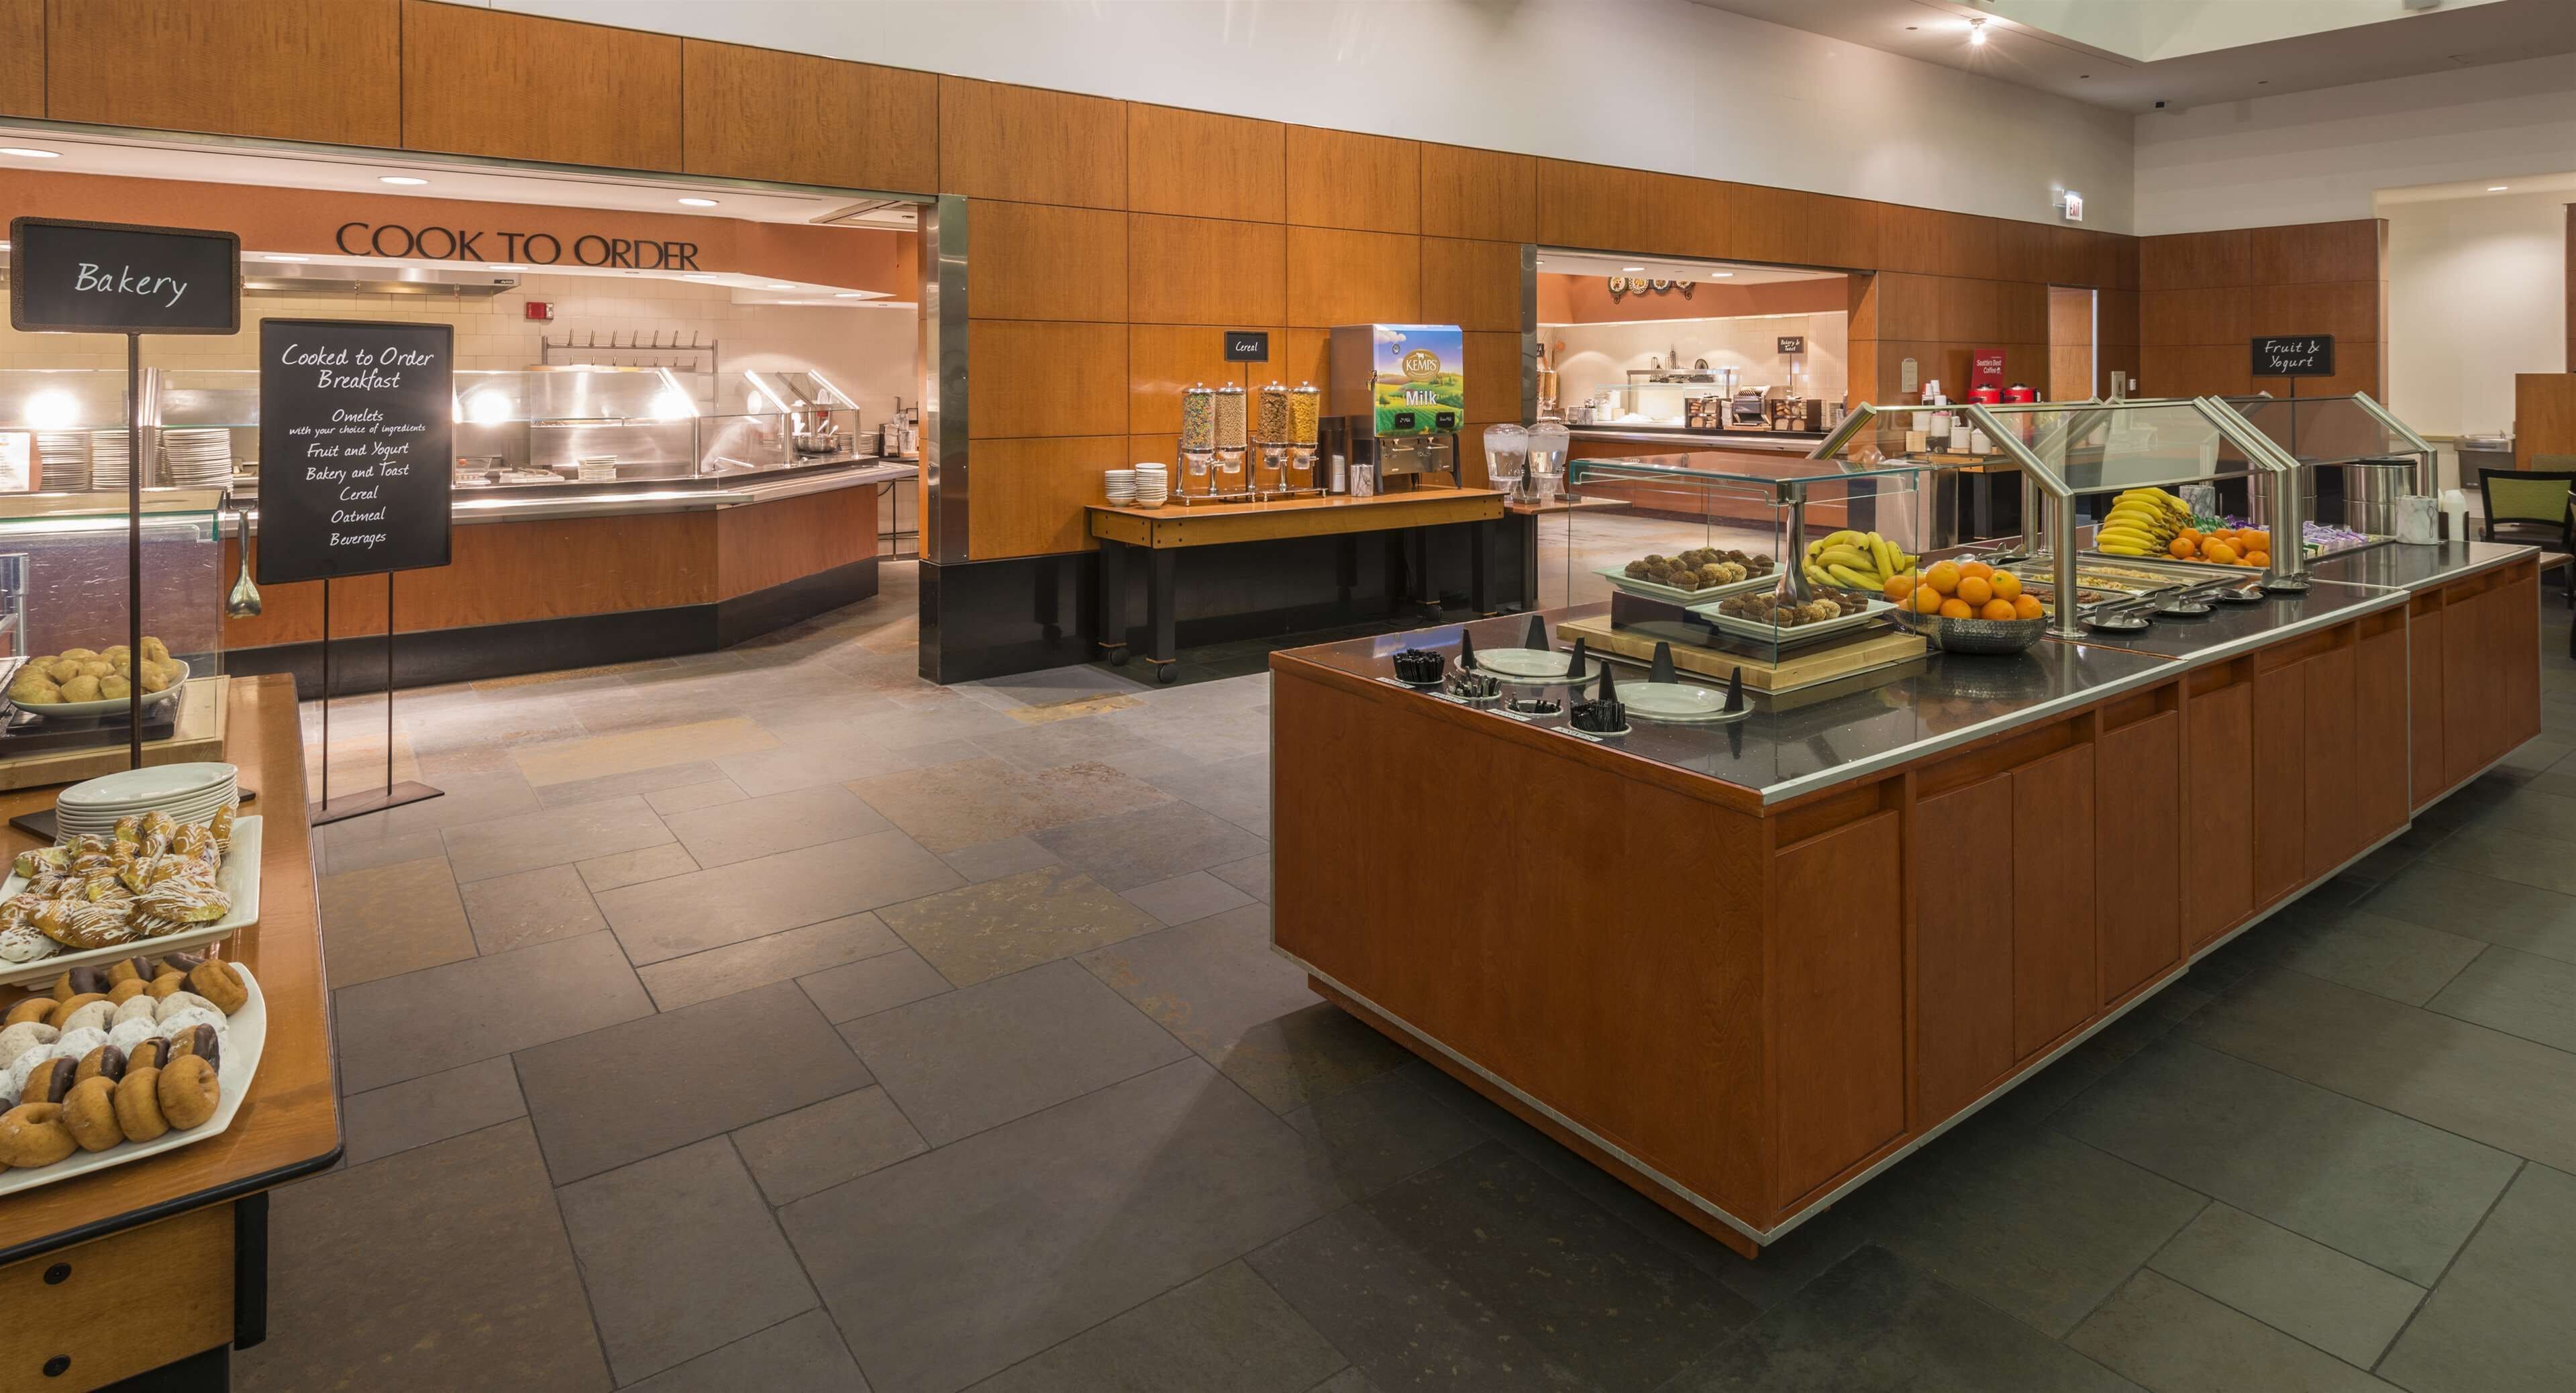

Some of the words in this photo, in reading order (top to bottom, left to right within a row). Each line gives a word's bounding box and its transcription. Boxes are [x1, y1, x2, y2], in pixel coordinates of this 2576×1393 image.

[336, 222, 484, 262] COOK
[497, 231, 562, 265] TO
[573, 234, 700, 271] ORDER
[74, 262, 188, 308] Bakery
[281, 344, 349, 366] Cooked
[355, 348, 374, 366] to
[379, 346, 435, 366] Order
[1235, 341, 1258, 352] Cereal
[2265, 340, 2302, 353] Fruit
[2308, 340, 2320, 354] &
[1406, 359, 1437, 371] KEMPS
[2269, 355, 2314, 373] Yogurt
[317, 367, 401, 391] Breakfast
[1406, 391, 1437, 407] Milk
[331, 407, 384, 423] Omelets
[289, 425, 311, 435] with
[314, 427, 336, 438] your
[339, 425, 366, 434] choice
[368, 422, 380, 434] of
[381, 423, 426, 437] ingredients
[307, 442, 340, 458] Fruit
[344, 444, 368, 456] and
[370, 441, 409, 462] Yogurt
[305, 466, 347, 484] Bakery
[351, 466, 374, 478] and
[378, 460, 410, 476] Toast
[340, 484, 379, 501] Cereal
[331, 506, 387, 523] Oatmeal
[329, 533, 387, 550] Beverages
